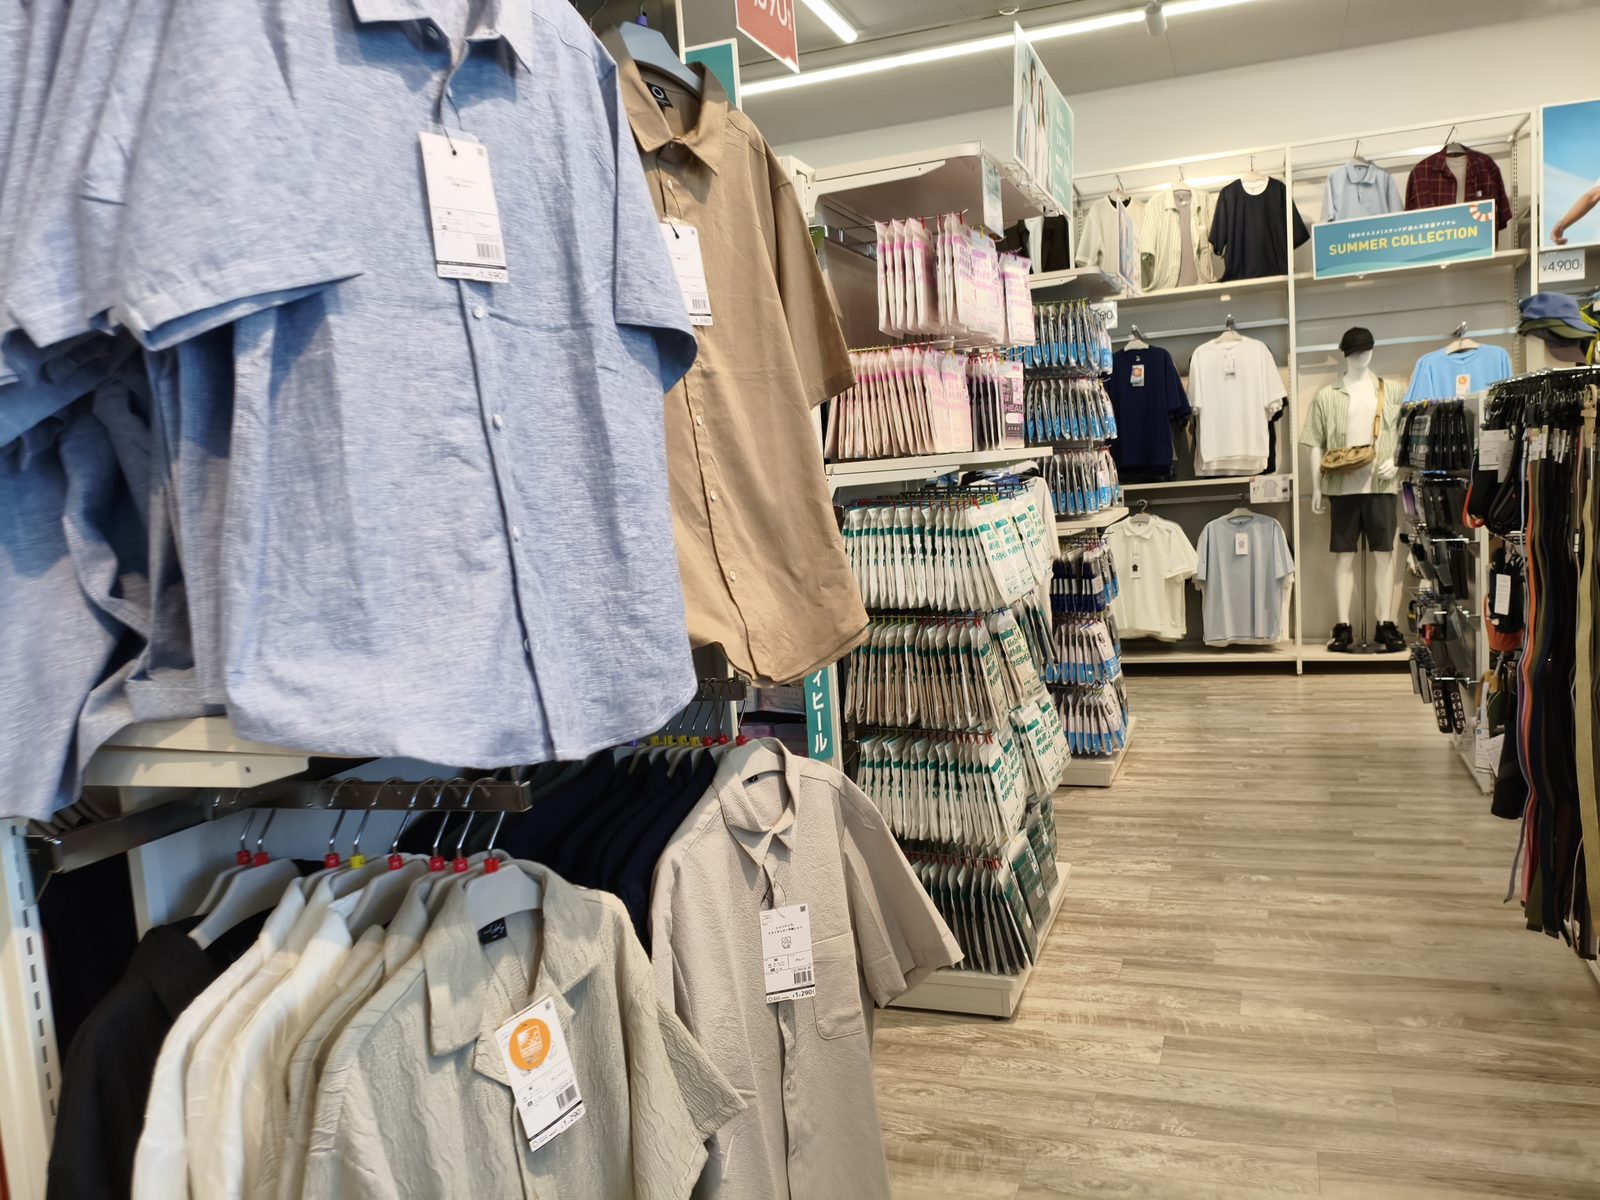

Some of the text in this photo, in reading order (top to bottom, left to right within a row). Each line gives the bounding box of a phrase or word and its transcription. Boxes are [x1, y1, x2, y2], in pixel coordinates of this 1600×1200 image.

[1329, 225, 1478, 256] SUMMER COLLECTION
[1543, 259, 1580, 273] ¥4,900
[812, 670, 828, 754] イヒール
